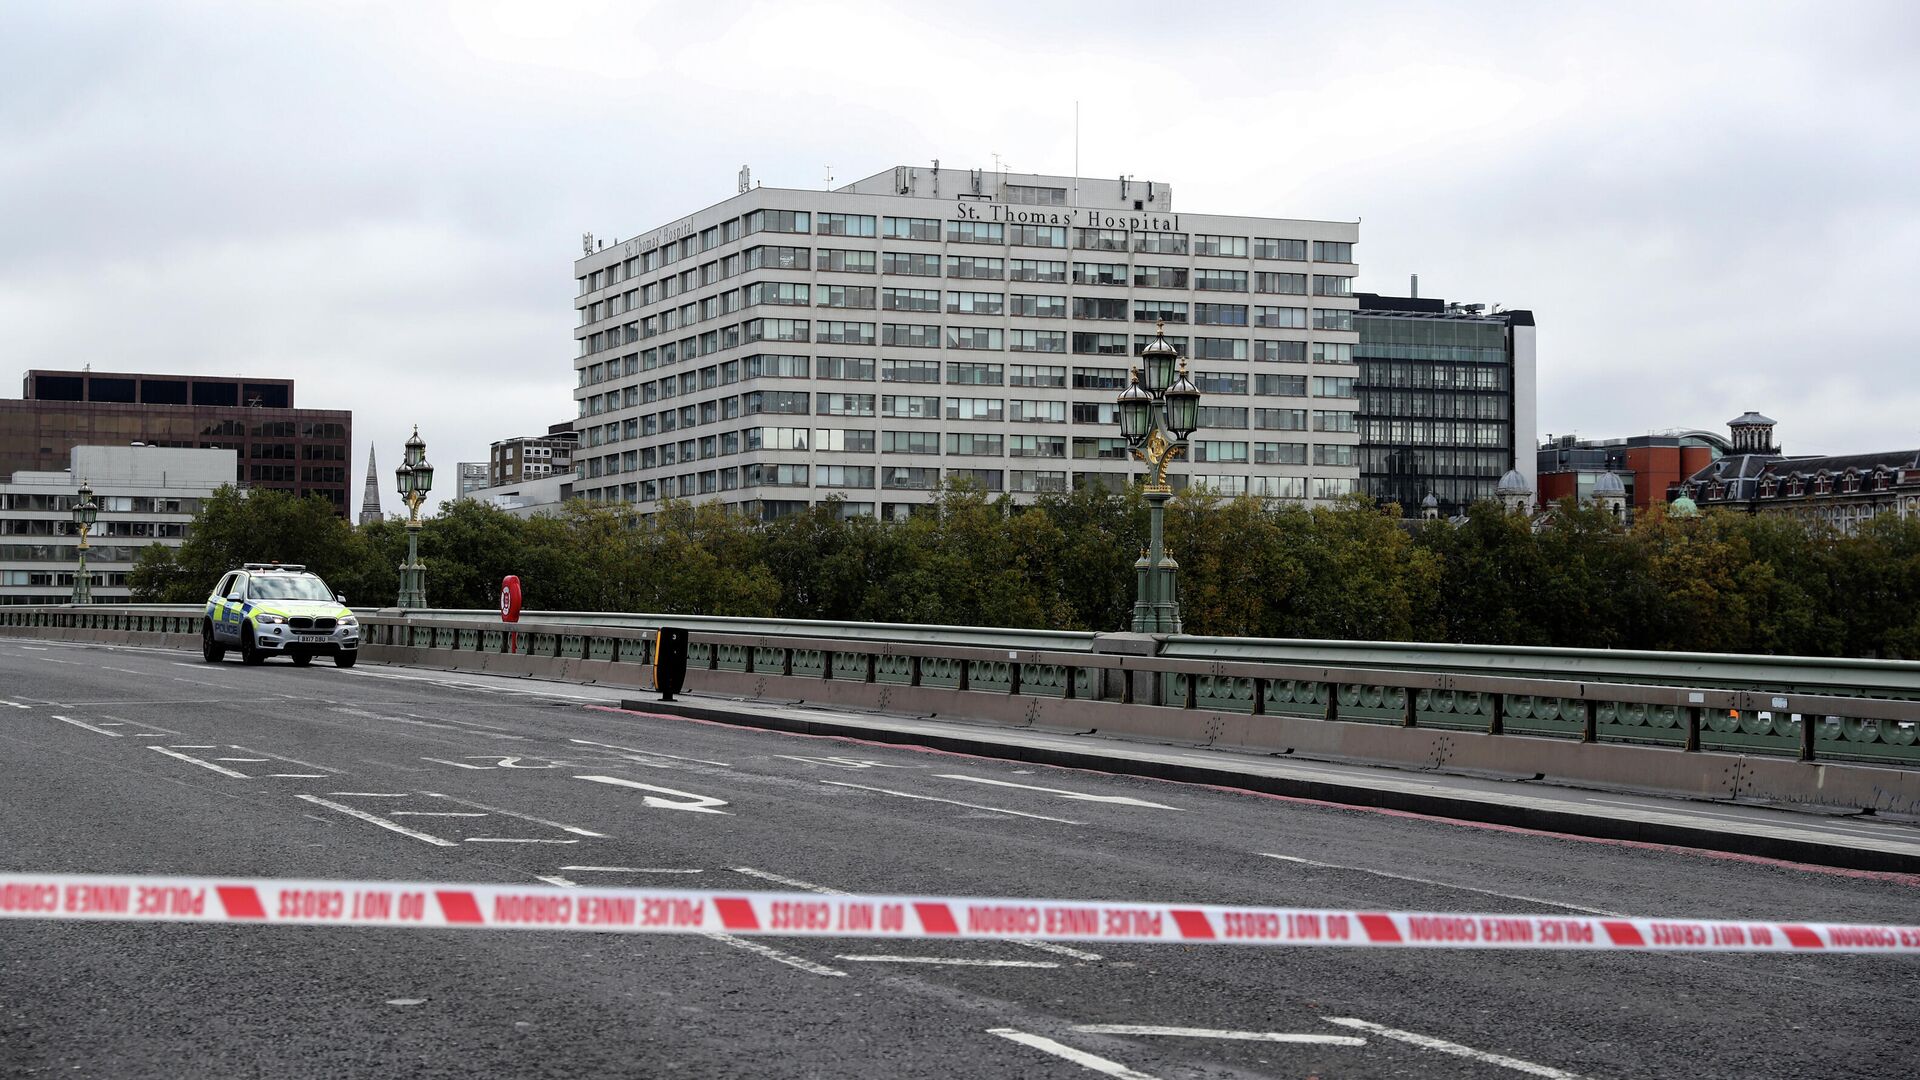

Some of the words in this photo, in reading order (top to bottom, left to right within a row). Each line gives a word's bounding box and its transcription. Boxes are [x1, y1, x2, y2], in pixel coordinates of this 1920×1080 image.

[663, 217, 694, 243] Hospital
[957, 202, 980, 220] St.
[990, 204, 1078, 225] Thomas'
[1089, 211, 1180, 234] Hospital
[215, 622, 238, 635] POLICE
[0, 883, 59, 912] CORD
[64, 884, 130, 912] INNER
[138, 886, 206, 916] POLICE
[278, 890, 344, 919] CROSS
[351, 892, 392, 919] NOT
[398, 892, 425, 920] DO
[494, 896, 573, 924] CORDON
[576, 897, 636, 925] INNER
[642, 899, 705, 927] POLICE
[770, 902, 831, 929] CROSS
[838, 904, 874, 930] NOT
[879, 905, 904, 932] DO
[968, 907, 1040, 933] CORDON
[1044, 909, 1099, 934] INNER
[1106, 911, 1163, 936] POLICE
[1224, 912, 1280, 938] CROSS
[1288, 915, 1322, 939] NOT
[1327, 915, 1350, 939] DO
[1409, 917, 1477, 941] CORDON
[1482, 920, 1533, 942] INNER
[1540, 921, 1594, 943] POLICE
[1652, 924, 1706, 944] CROSS
[1714, 927, 1745, 944] NOT
[1751, 928, 1773, 945] DO
[1830, 928, 1896, 946] CORDON
